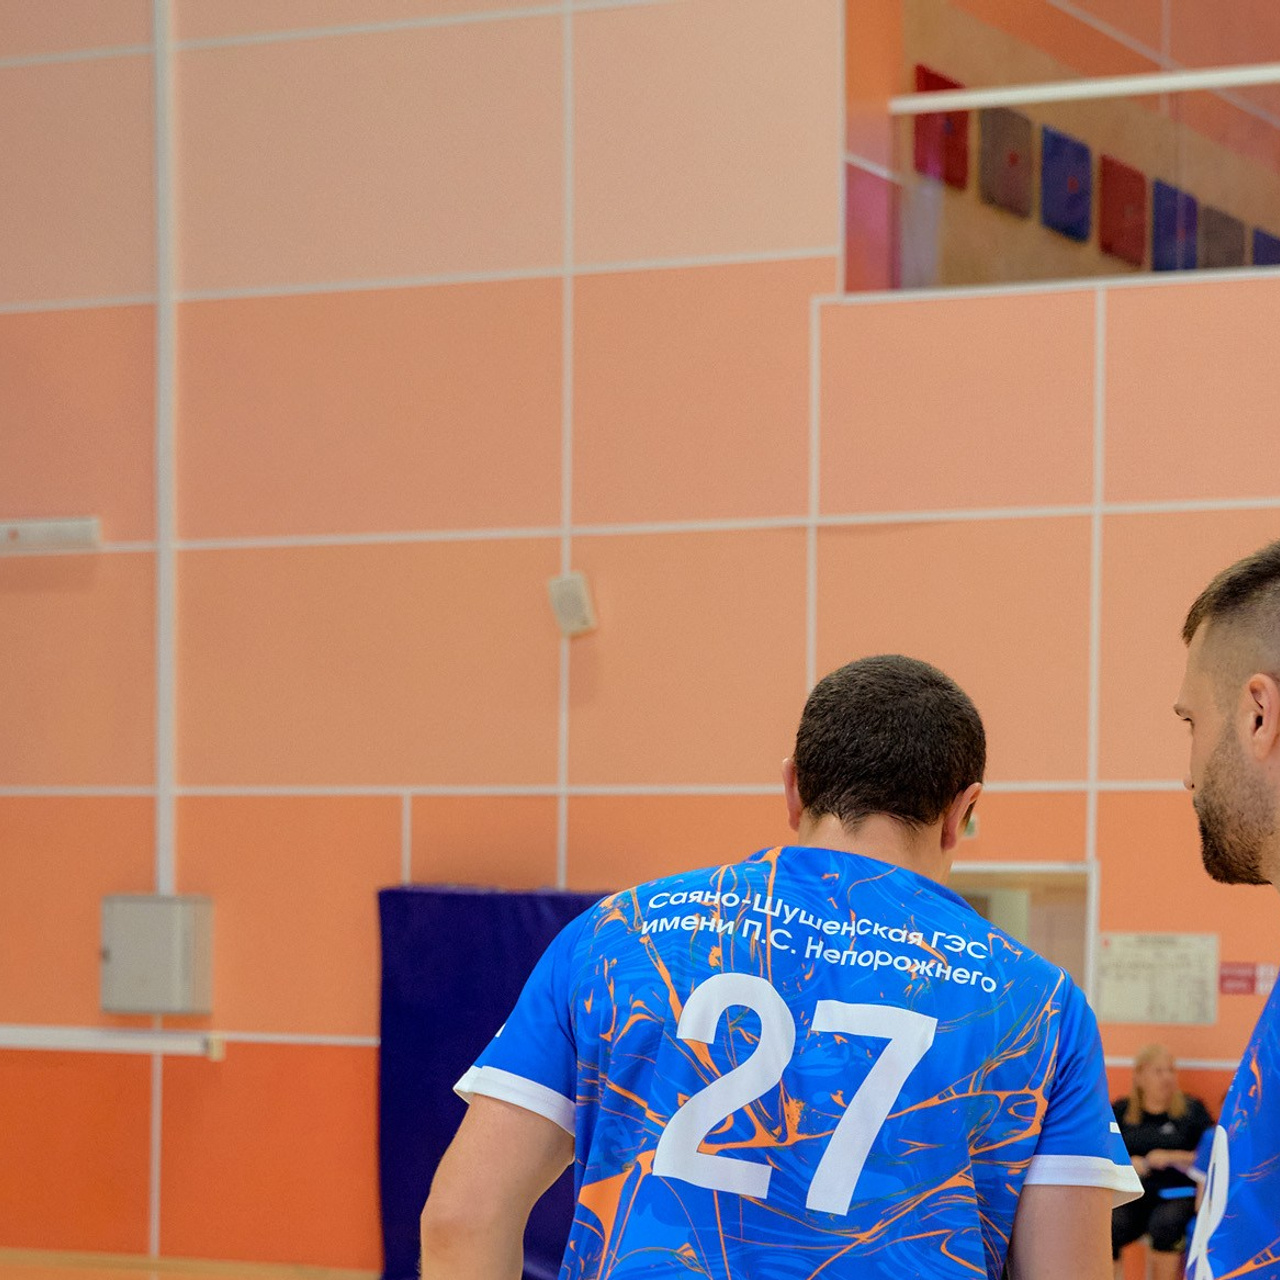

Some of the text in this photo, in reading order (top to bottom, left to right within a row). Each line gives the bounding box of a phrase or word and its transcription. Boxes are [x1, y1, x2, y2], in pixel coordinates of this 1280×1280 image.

[641, 912, 998, 994] имени П.С. Непорожнего
[648, 889, 990, 960] Саяно-Шушенская ГЭС
[652, 972, 938, 1217] 27
